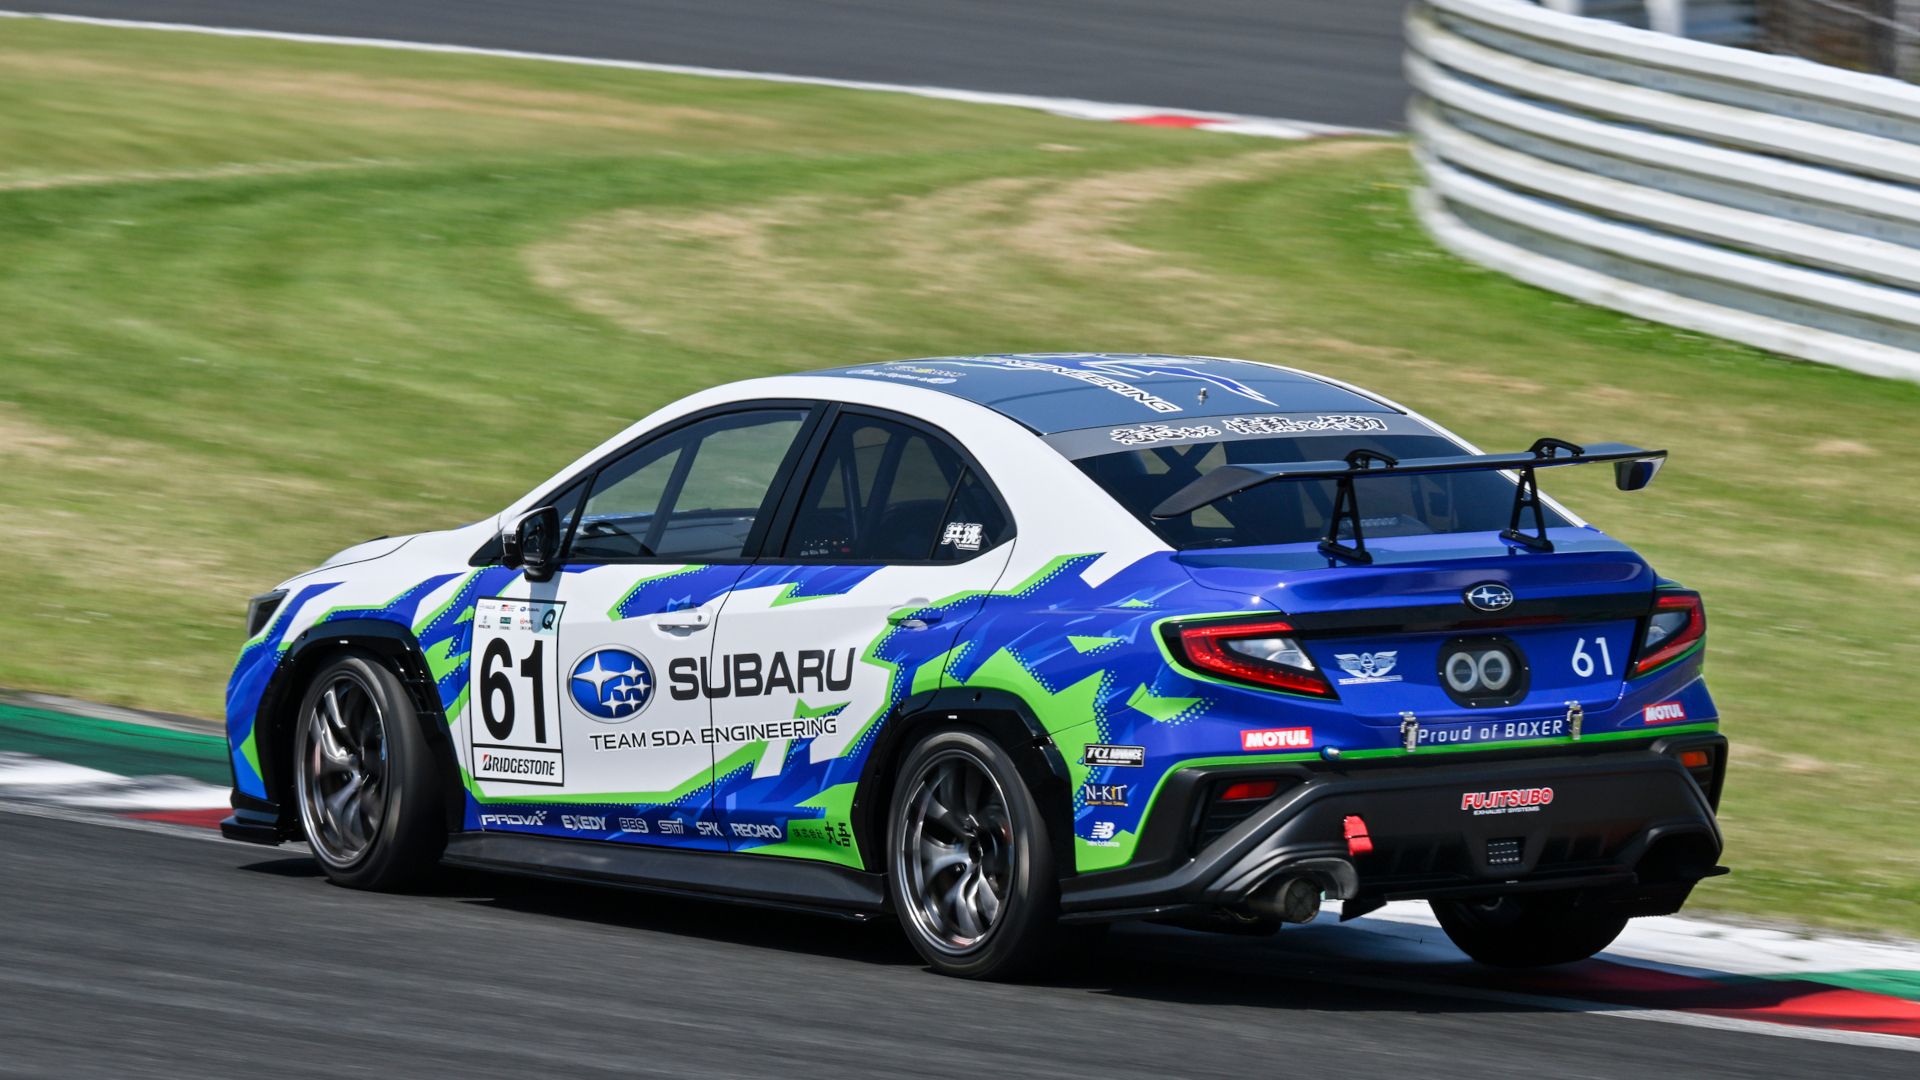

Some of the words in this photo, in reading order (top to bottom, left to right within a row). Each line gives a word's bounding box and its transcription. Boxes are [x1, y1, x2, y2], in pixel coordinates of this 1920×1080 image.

[541, 609, 557, 630] Q
[1571, 637, 1613, 677] 61
[668, 647, 856, 701] SUBARU
[480, 637, 547, 744] 61
[1645, 704, 1684, 721] MOTUL
[590, 732, 647, 750] TEAM
[652, 729, 696, 746] SDA
[701, 718, 837, 744] ENGINEERING
[1245, 730, 1309, 748] MOTUL
[1417, 726, 1472, 743] Proud
[1480, 724, 1498, 740] of
[1505, 720, 1563, 738] BOXER
[483, 754, 555, 776] BRIDGESTONE
[1461, 787, 1554, 811] FUJITSUBO
[481, 814, 544, 826] PROVA
[560, 814, 607, 830] EXEDY
[619, 817, 649, 833] BBS
[695, 821, 724, 837] SPK
[729, 822, 783, 839] RECARO
